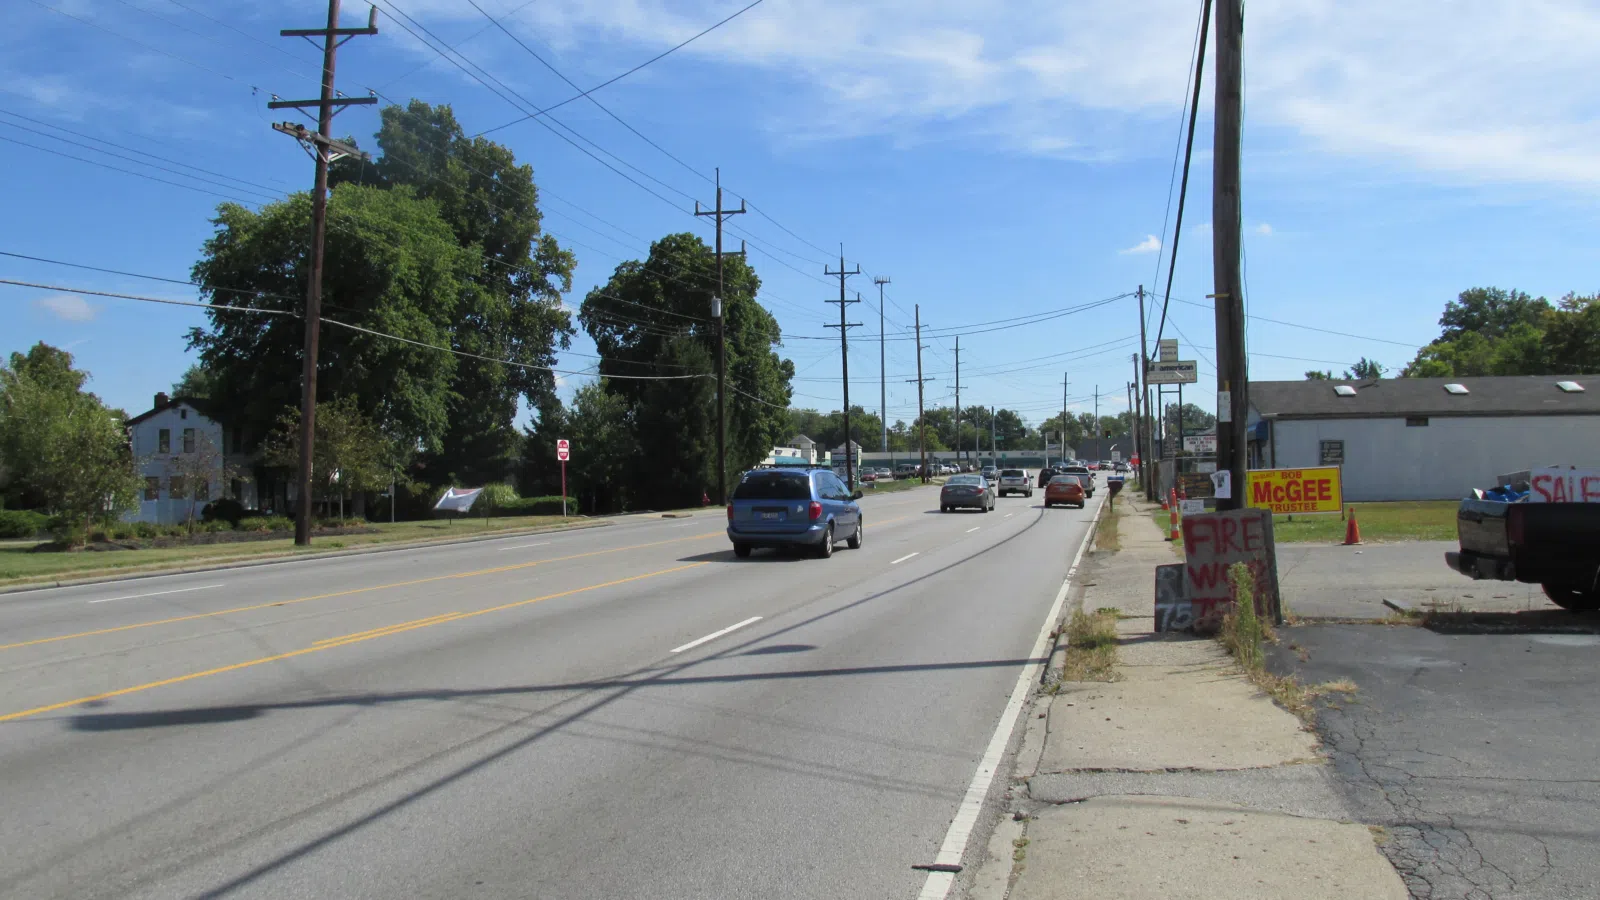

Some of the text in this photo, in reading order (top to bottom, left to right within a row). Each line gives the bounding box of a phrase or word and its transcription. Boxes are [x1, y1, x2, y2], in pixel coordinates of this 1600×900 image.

[1281, 471, 1302, 479] BOB
[1253, 479, 1332, 504] McGEE
[1268, 502, 1317, 512] TRUSTEE
[1182, 515, 1262, 557] FIRE
